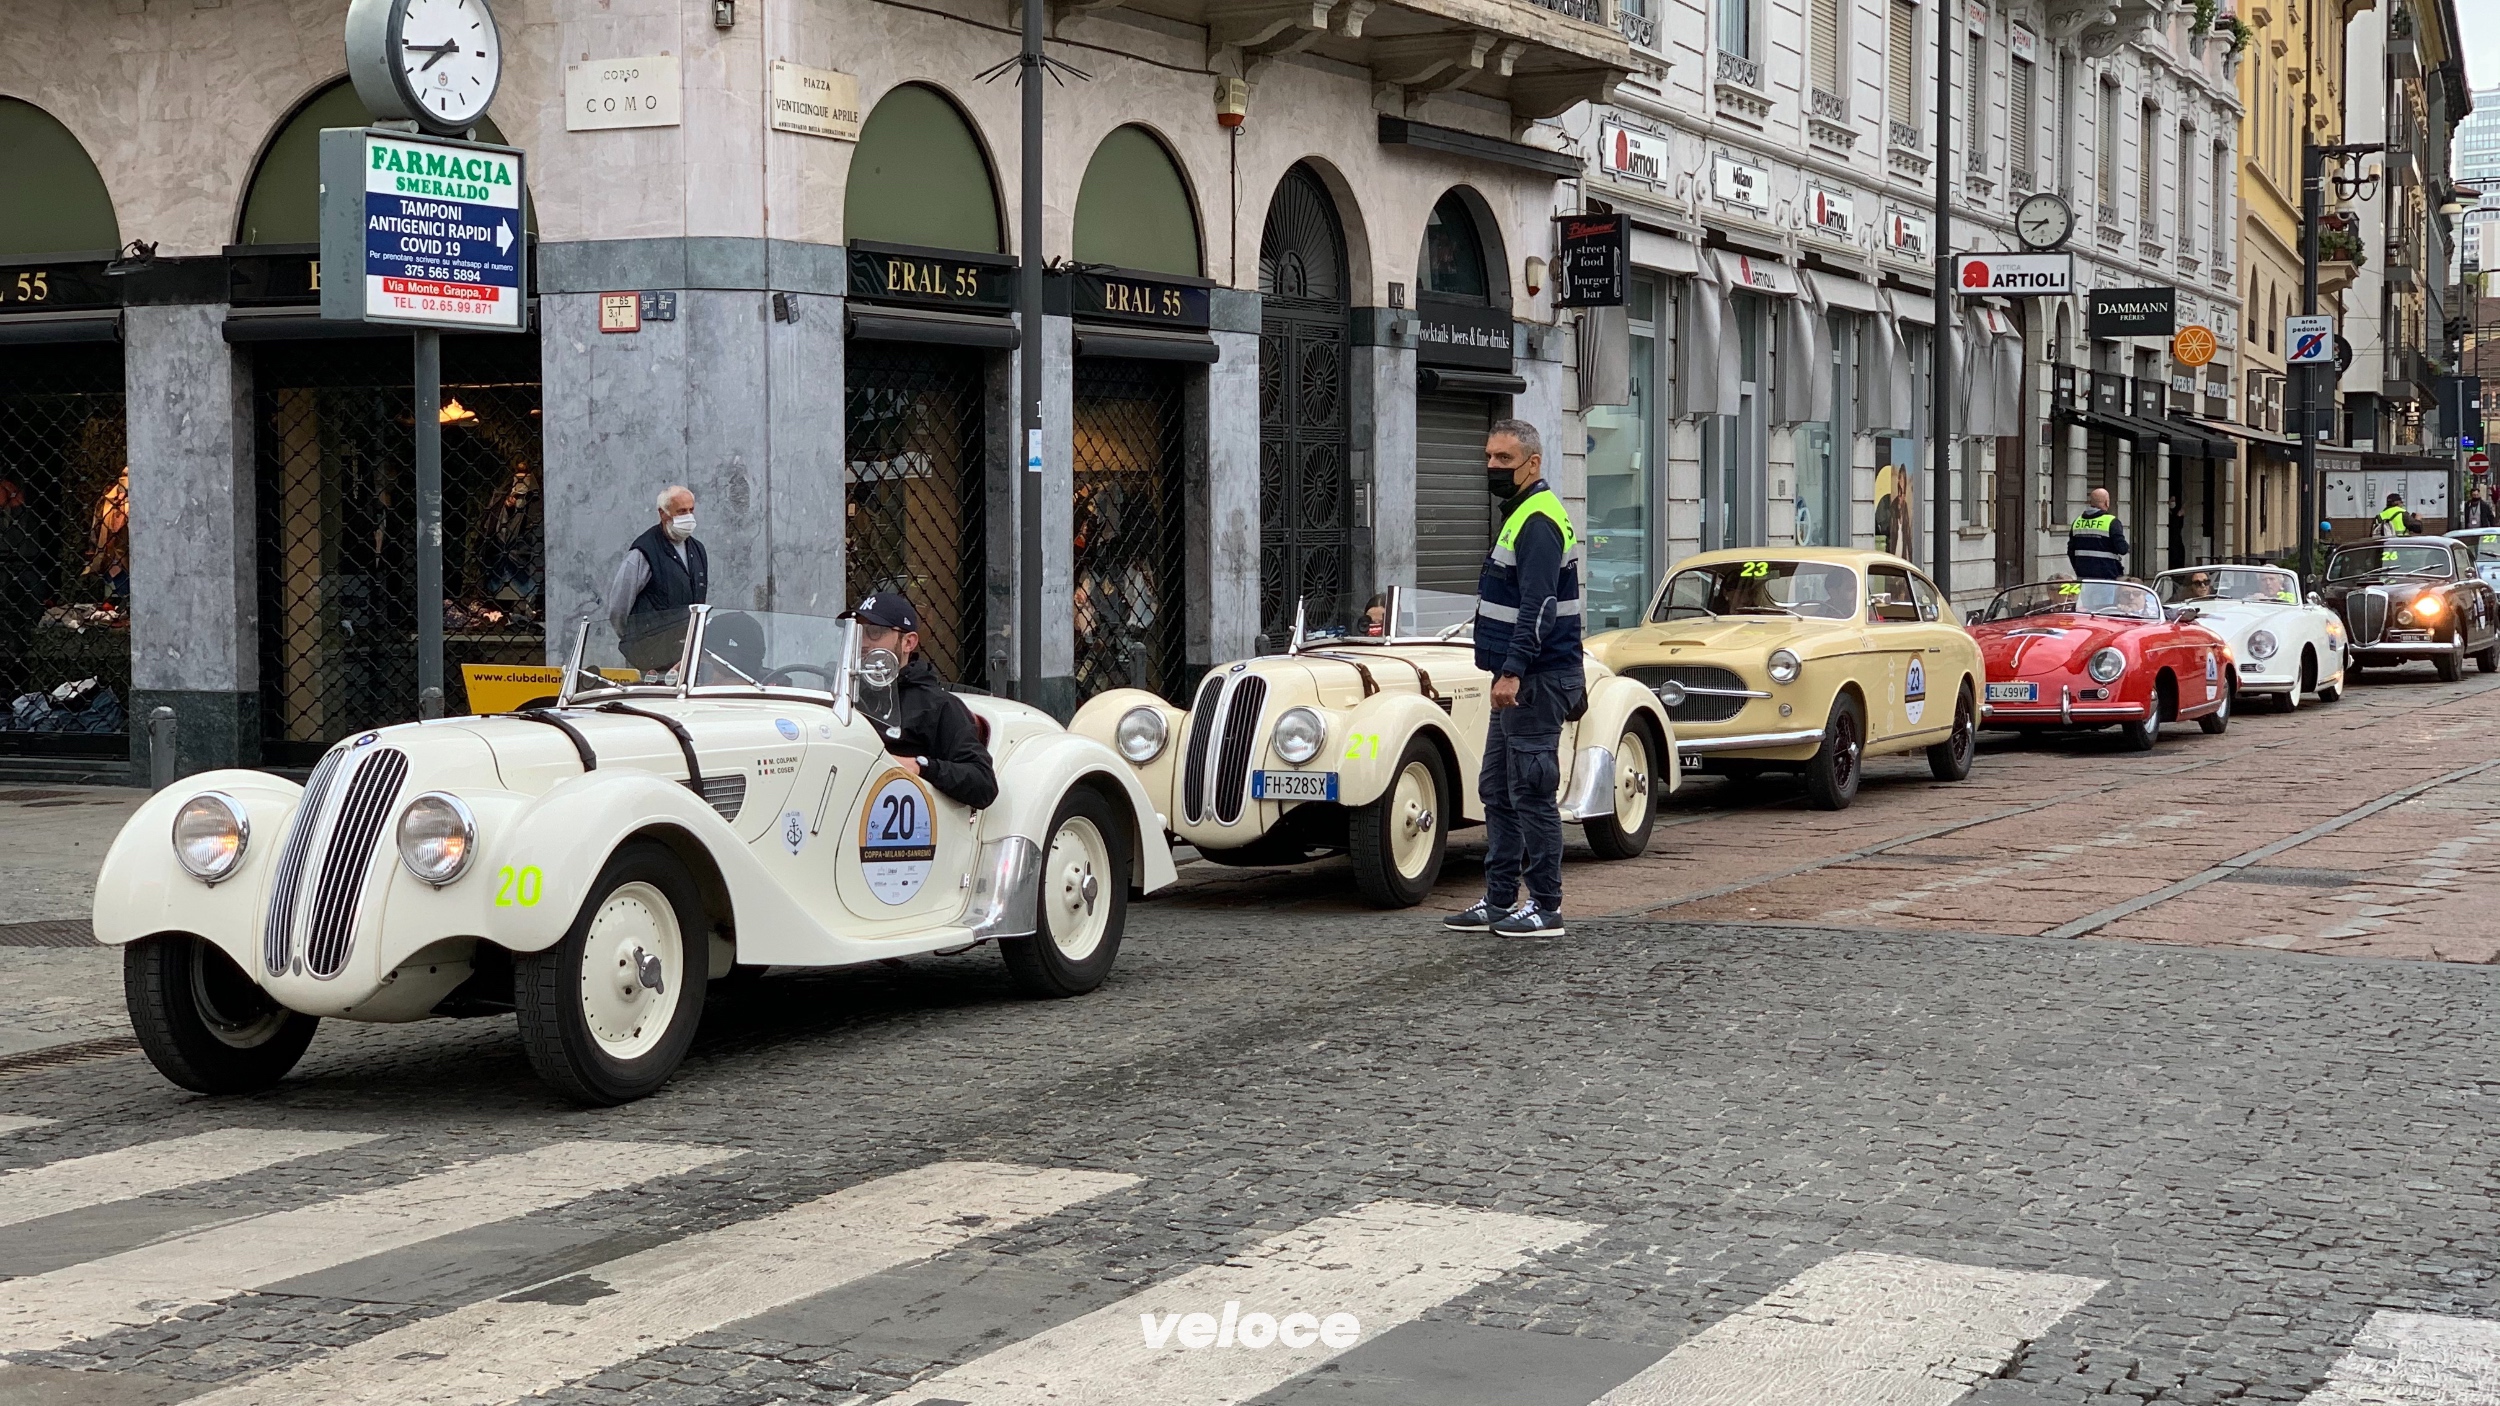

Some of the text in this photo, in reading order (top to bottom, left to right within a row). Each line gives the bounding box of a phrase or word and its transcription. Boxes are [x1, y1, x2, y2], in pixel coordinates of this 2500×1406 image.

[804, 77, 831, 91] PIAZZA
[586, 95, 657, 113] COMO
[776, 98, 858, 124] VENTICINQUE APRILE
[372, 146, 512, 186] FARMACIA
[1628, 152, 1658, 178] ARTIOLI
[1732, 166, 1753, 189] Milano
[396, 176, 490, 200] SMERALDO
[400, 200, 462, 220] TAMPONI
[368, 214, 491, 242] ANTIGENICI RAPIDI
[1826, 210, 1848, 232] ARTIOLI
[400, 236, 461, 256] COVID 19
[1576, 244, 1607, 254] street
[1902, 232, 1921, 252] ARTIOLI
[370, 250, 380, 258] Per
[382, 252, 414, 262] prenotare
[416, 255, 440, 264] scrivere
[452, 258, 482, 269] whatsapp
[491, 263, 514, 272] numero
[1580, 256, 1604, 266] food
[404, 264, 481, 282] 375 565 5894
[887, 260, 977, 297] ERAL 55
[1574, 274, 1610, 288] burger
[1751, 270, 1776, 289] ARTIOLI
[1992, 272, 2065, 288] ARTIOLI
[17, 272, 48, 302] 55
[388, 280, 492, 300] Via Monte Grappa, 7
[1583, 288, 1602, 298] bar
[394, 296, 492, 314] TEL. 02.65.99.871
[620, 296, 629, 306] 65
[1104, 282, 1181, 316] ERAL 55
[2098, 302, 2168, 314] DAMMANN
[1420, 322, 1510, 350] cocktails beers & fine drinks
[2292, 326, 2326, 334] pedonale
[2075, 520, 2104, 528] STAFF
[2482, 535, 2496, 543] 27
[2382, 552, 2398, 560] 26
[1740, 562, 1769, 577] 23
[2059, 584, 2081, 594] 24
[1910, 666, 1920, 692] 23
[1345, 734, 1380, 760] 21
[776, 756, 798, 764] COLPANI
[1685, 756, 1698, 766] VA
[778, 766, 794, 774] COSER
[882, 794, 915, 840] 20
[495, 864, 544, 908] 20
